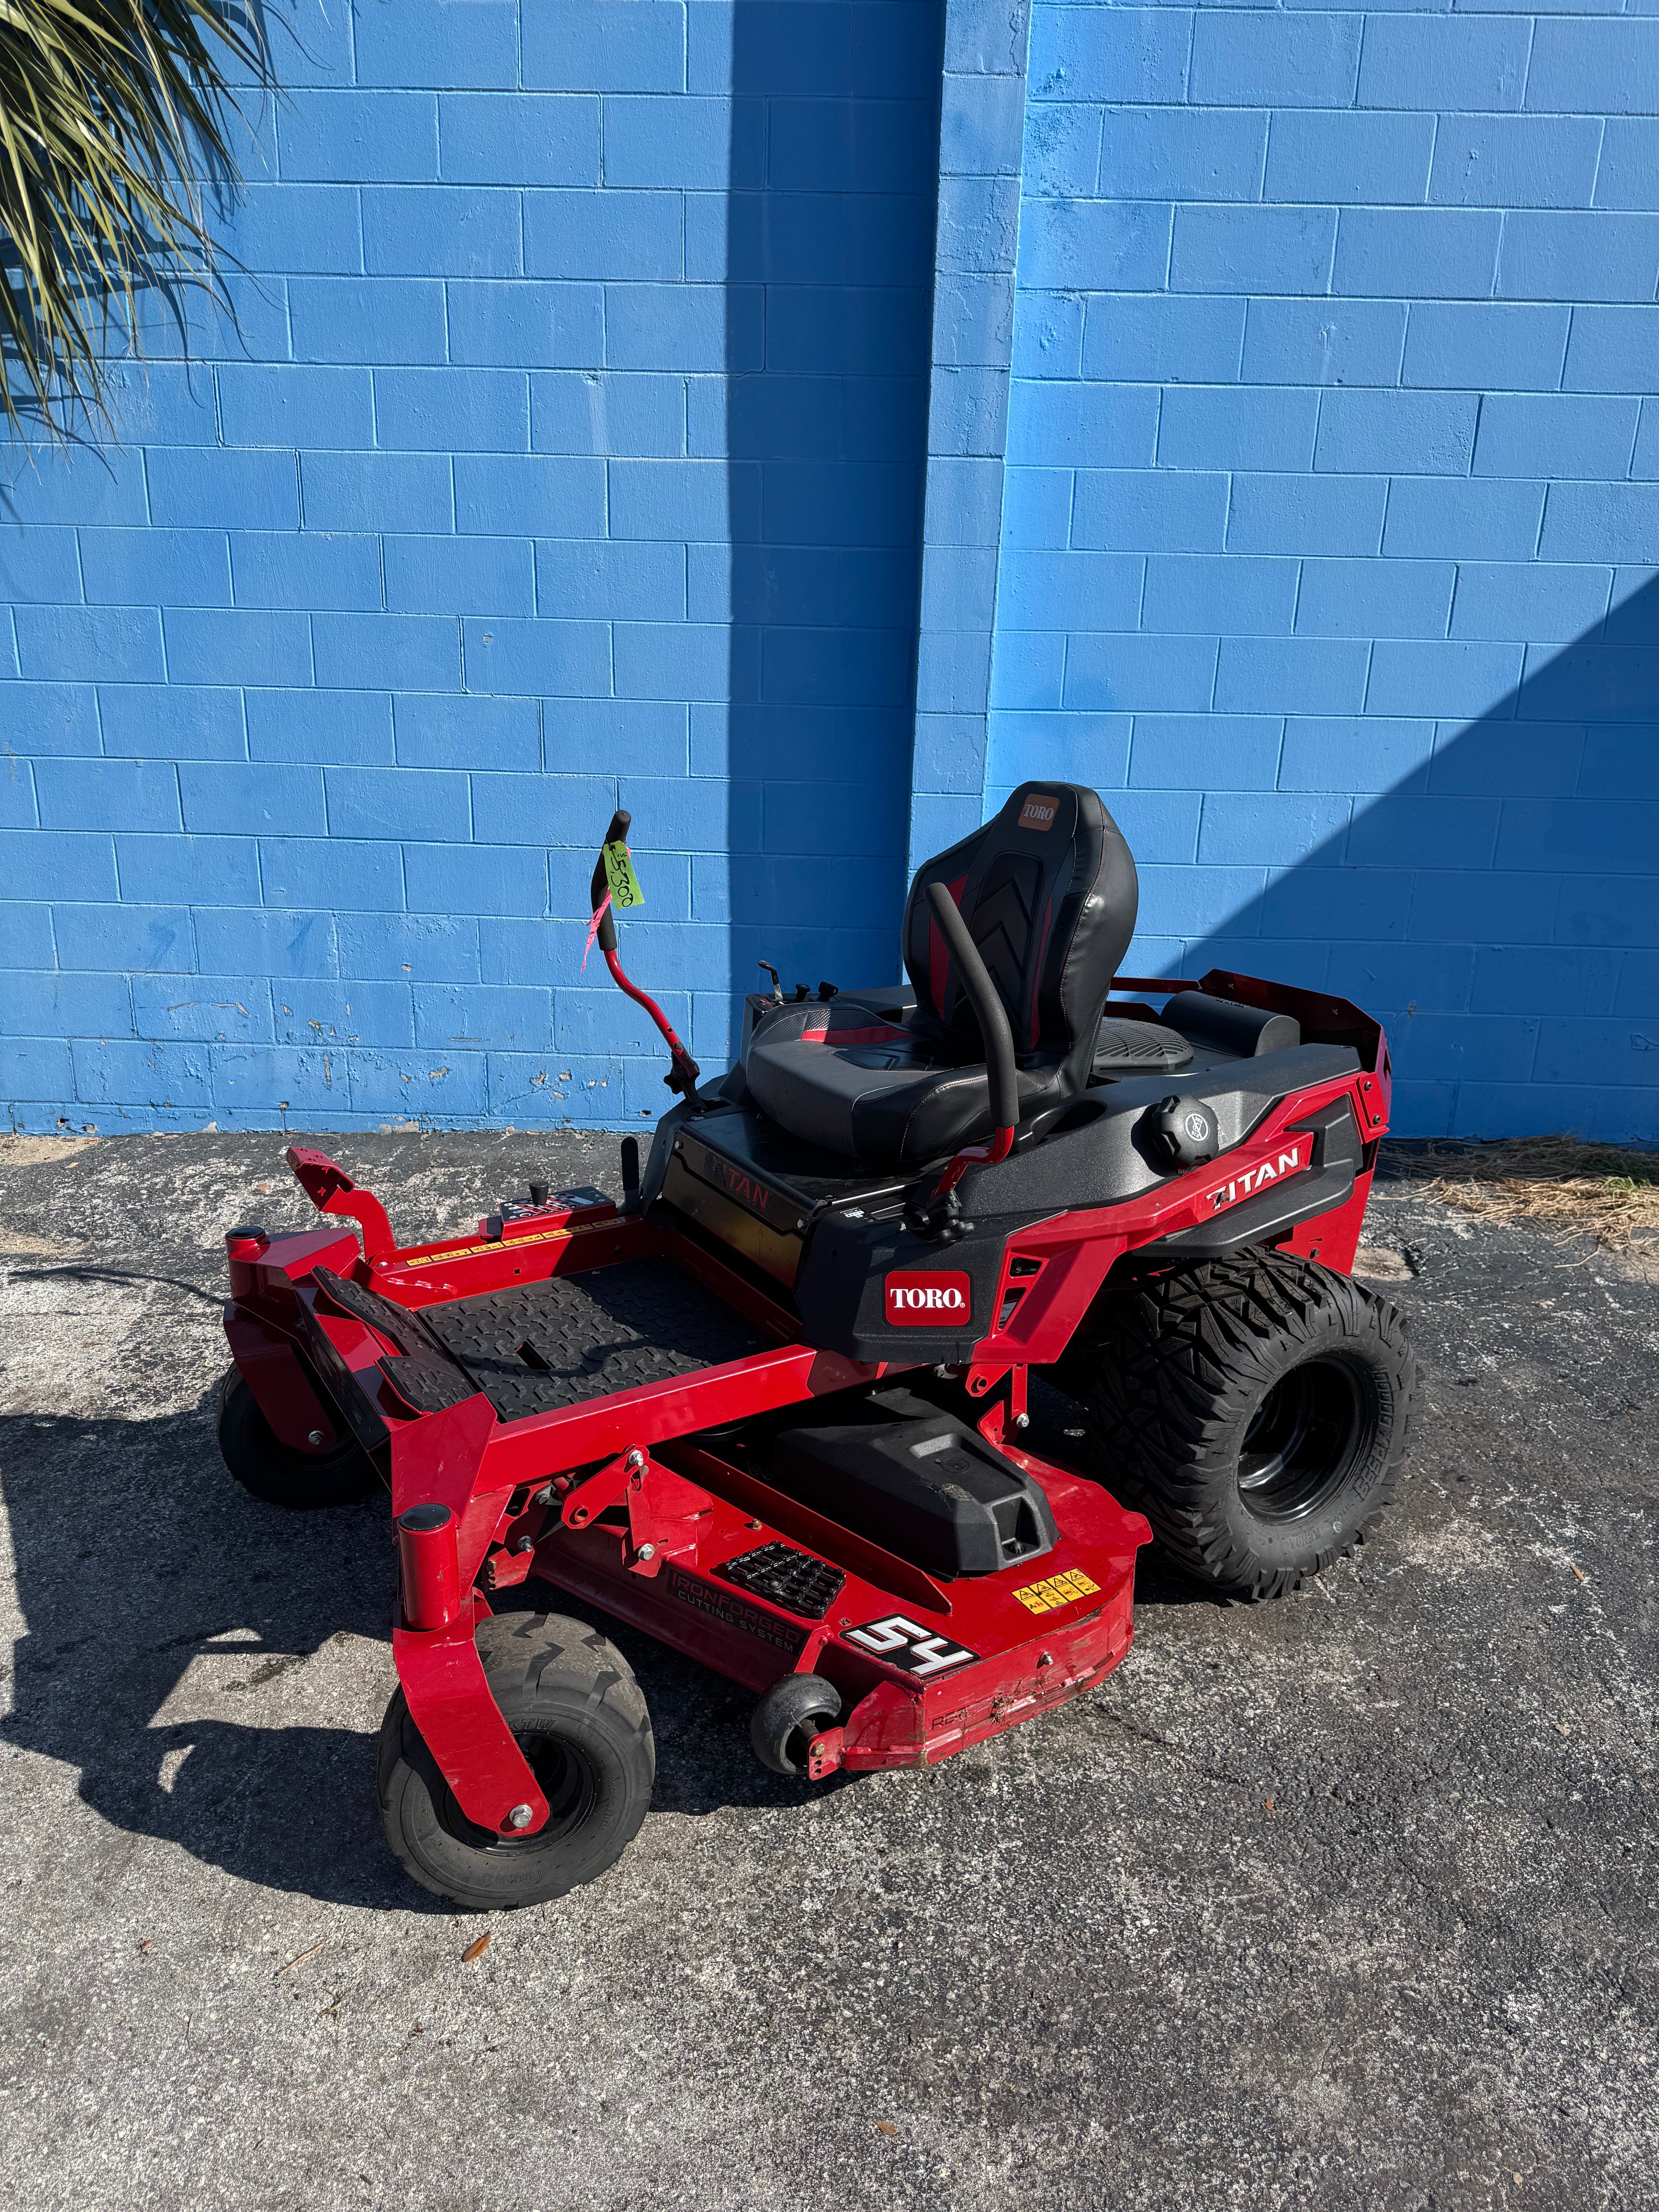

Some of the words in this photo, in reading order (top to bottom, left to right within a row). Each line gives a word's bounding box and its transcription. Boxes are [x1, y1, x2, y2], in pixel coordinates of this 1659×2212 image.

[1024, 804, 1054, 821] TORO
[890, 1288, 962, 1308] TORO
[672, 1572, 800, 1644] IRONFORGED
[678, 1590, 733, 1622] CUTTING
[739, 1620, 793, 1653] SYSTEM
[845, 1616, 974, 1676] 54
